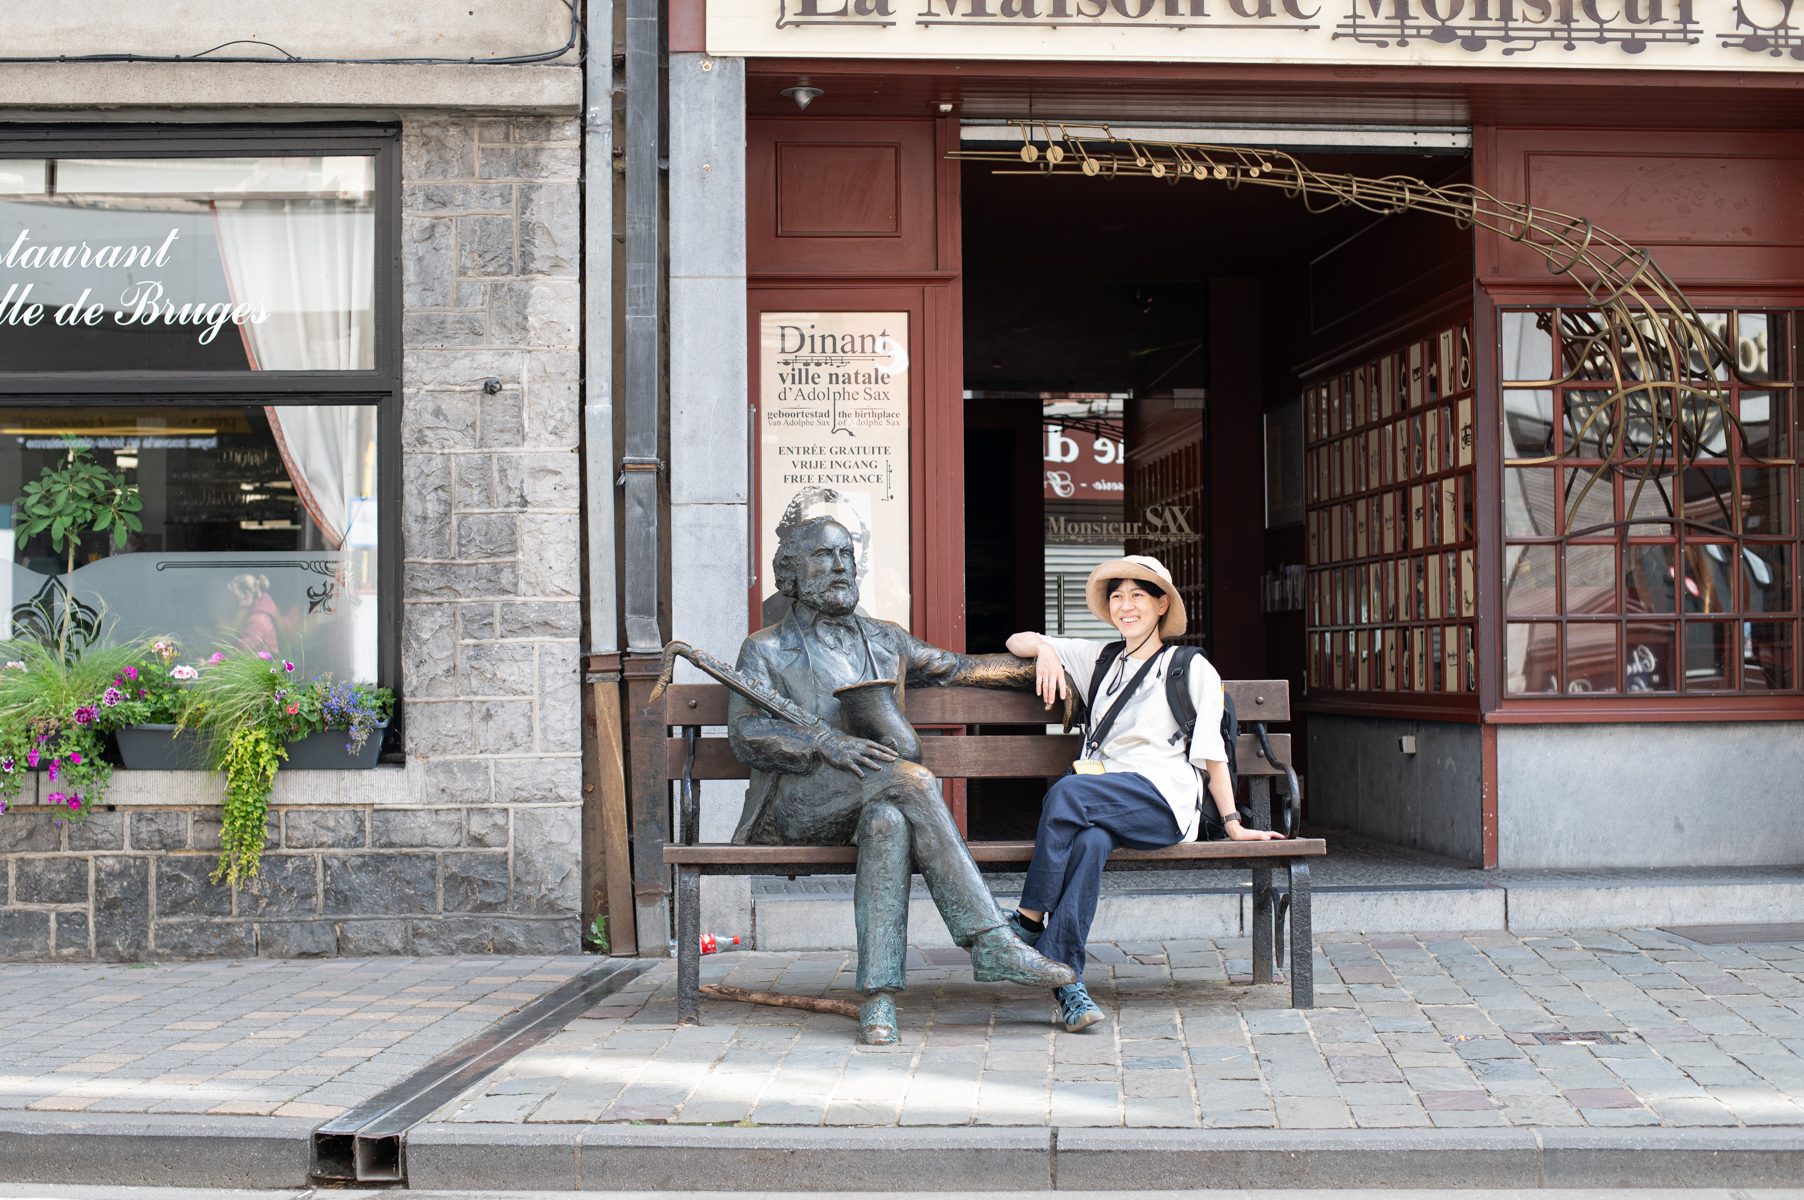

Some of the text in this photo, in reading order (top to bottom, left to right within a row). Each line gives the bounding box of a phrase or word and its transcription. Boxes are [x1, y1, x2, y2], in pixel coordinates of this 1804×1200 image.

[0, 228, 180, 269] taurant
[53, 287, 104, 326] de
[114, 280, 272, 345] Bruges
[777, 324, 890, 355] Dinant
[778, 368, 891, 385] ville natale
[863, 387, 891, 401] Sax
[767, 409, 830, 420] geboortestad
[838, 409, 901, 421] the birthplace
[783, 418, 815, 428] Adolphe
[816, 418, 831, 427] Sax
[838, 418, 901, 428] of Adolphe Sax
[778, 444, 891, 456] ENTRÉE GRATUITE
[791, 460, 878, 470] VRIJE INGANG
[783, 474, 884, 484] FREE ENTRANCE
[1048, 505, 1193, 536] Monsieur SAX
